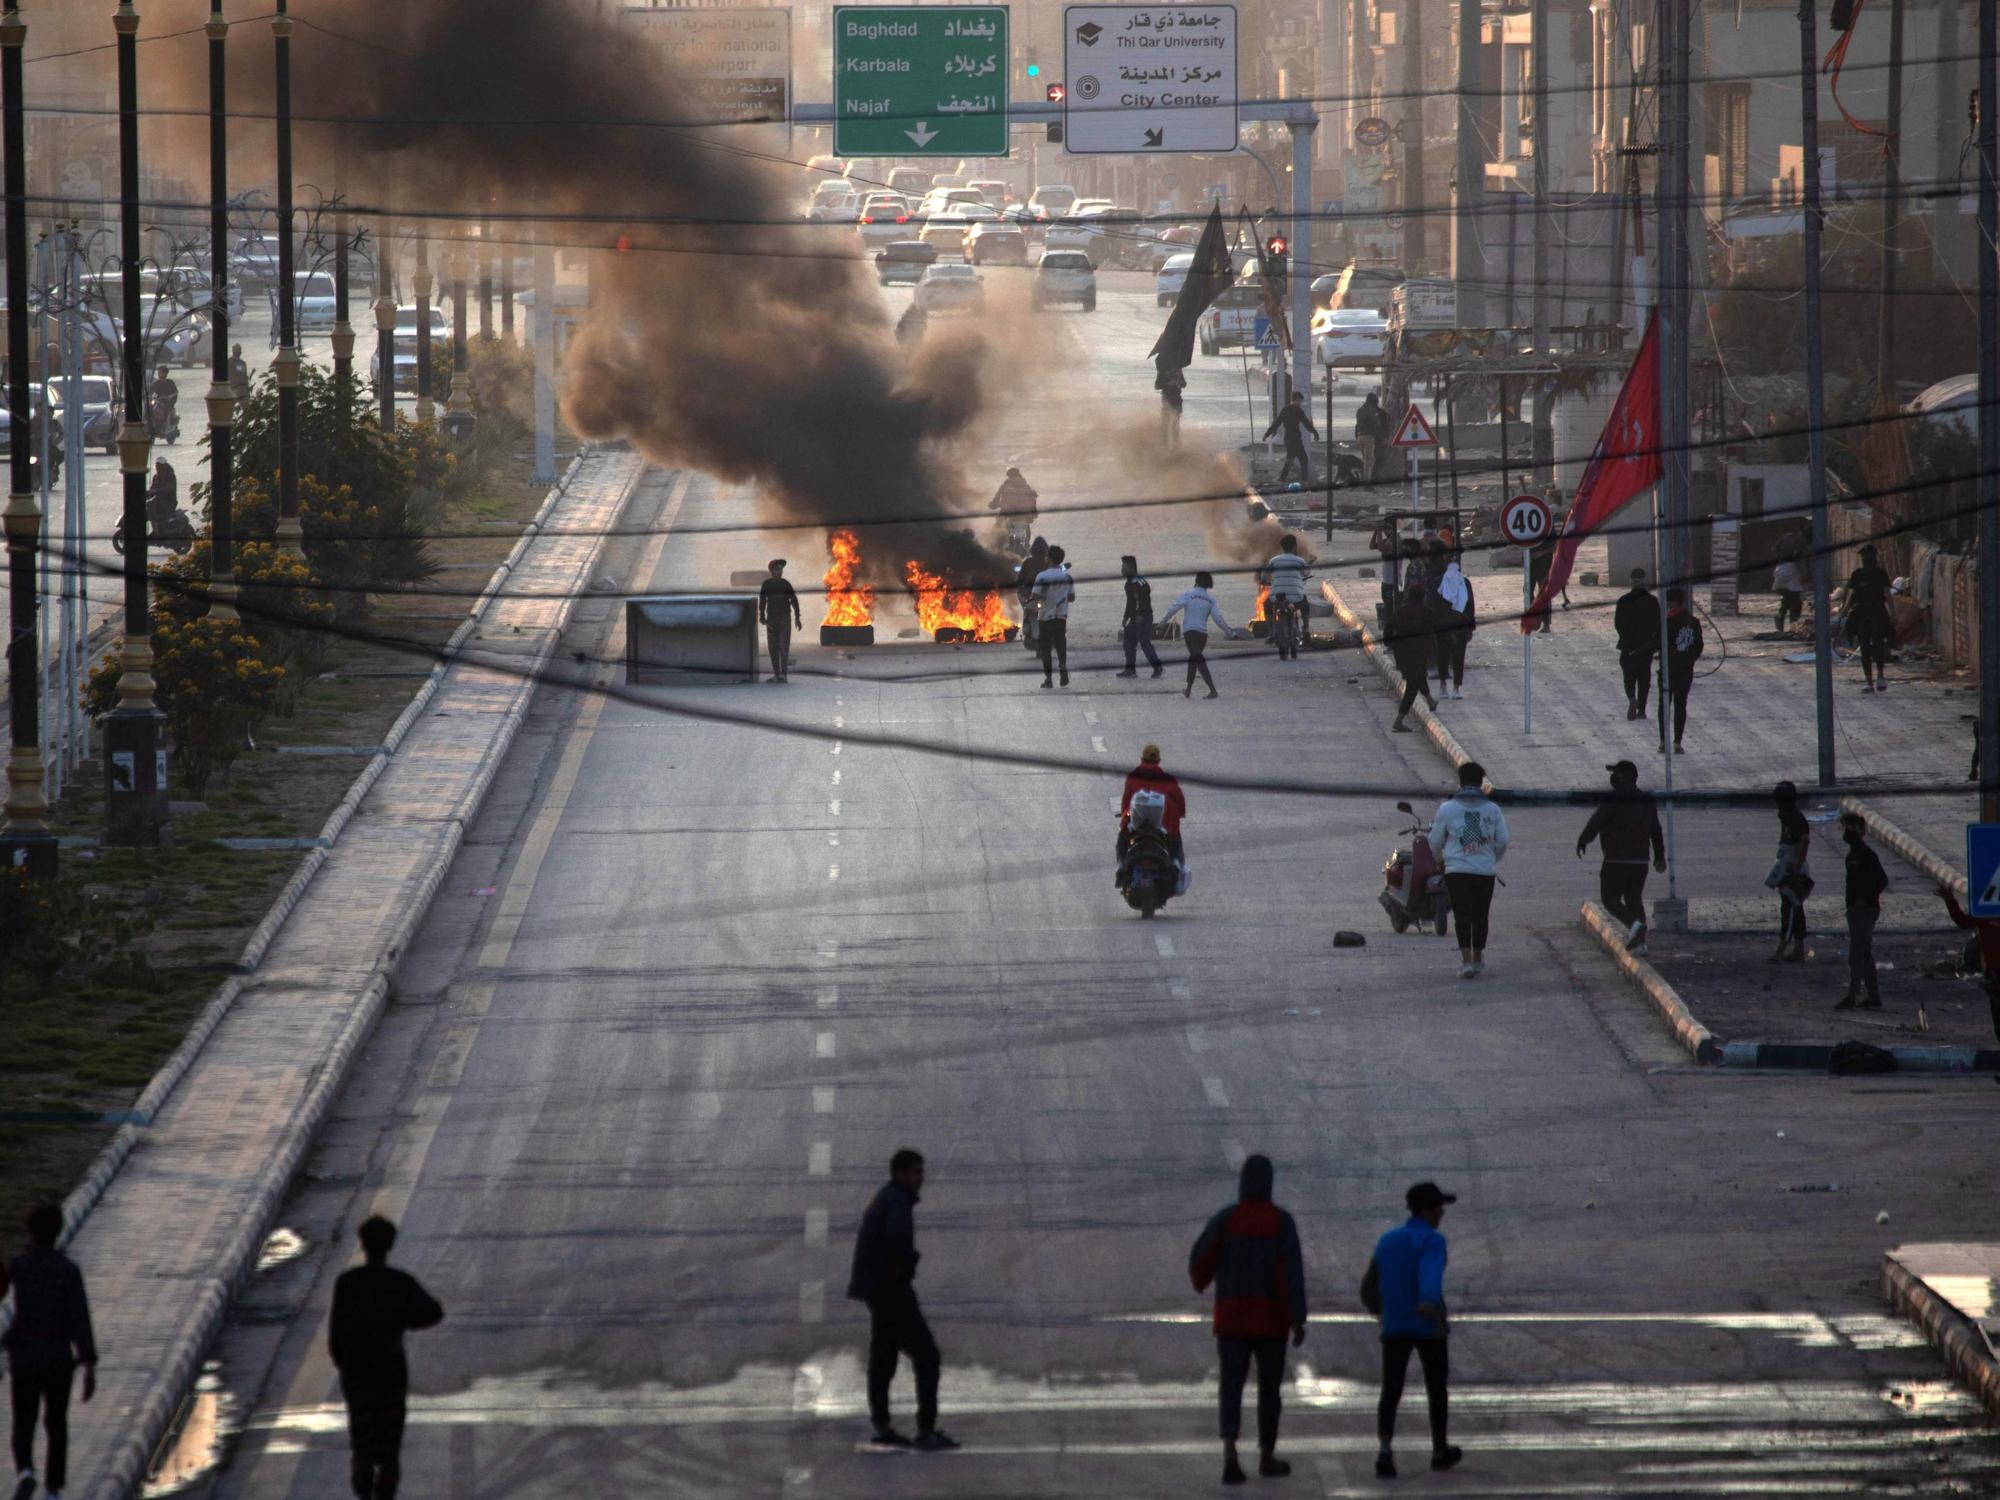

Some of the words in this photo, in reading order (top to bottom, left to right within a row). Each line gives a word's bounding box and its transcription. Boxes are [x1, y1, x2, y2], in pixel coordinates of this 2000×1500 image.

[944, 18, 996, 42] بغداد
[1125, 12, 1150, 31] قار
[1154, 12, 1174, 32] ذي
[1177, 12, 1221, 30] جامعة
[846, 22, 918, 40] Baghdad
[1116, 36, 1135, 48] Thi
[1138, 36, 1160, 48] Qar
[1164, 35, 1226, 49] University
[846, 57, 911, 72] Karbala
[944, 55, 997, 78] كربلاء
[1118, 65, 1175, 85] المدينة
[1179, 66, 1222, 83] مركز
[846, 98, 891, 116] Najaf
[936, 94, 996, 118] النجف
[1120, 93, 1155, 108] City
[1160, 93, 1220, 107] Center
[1230, 315, 1255, 326] TOYO
[1512, 509, 1542, 534] 40
